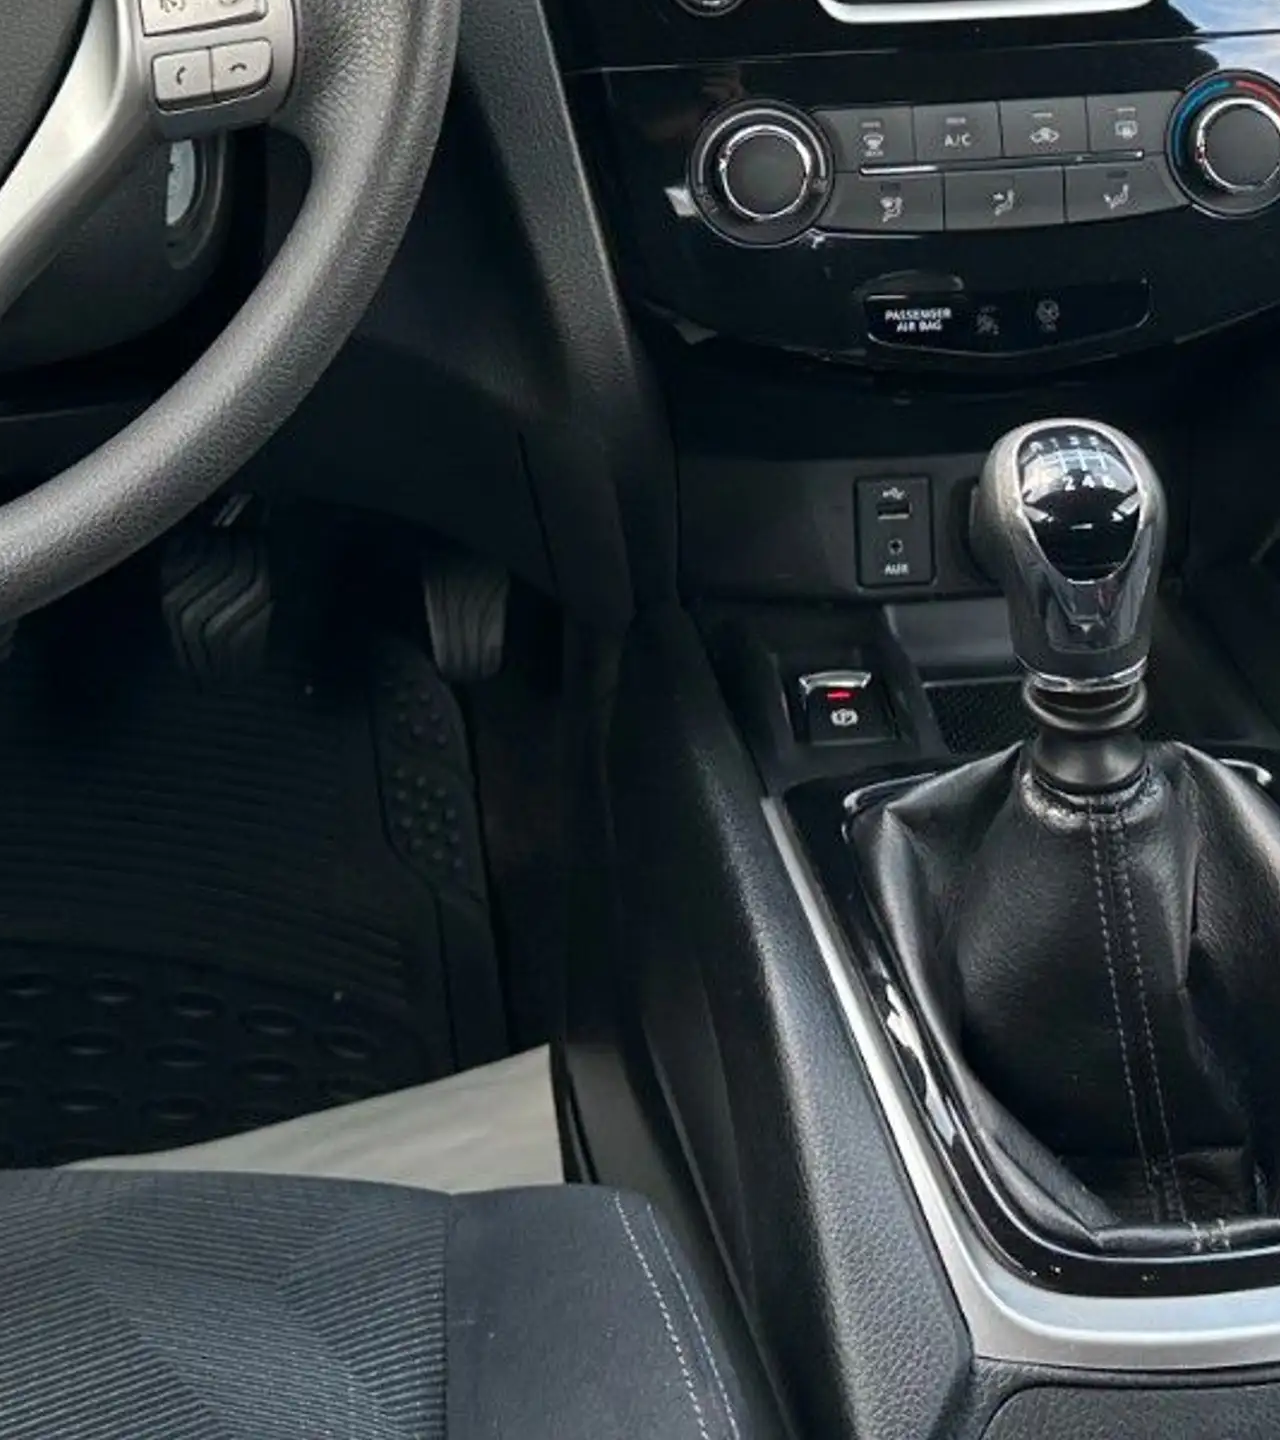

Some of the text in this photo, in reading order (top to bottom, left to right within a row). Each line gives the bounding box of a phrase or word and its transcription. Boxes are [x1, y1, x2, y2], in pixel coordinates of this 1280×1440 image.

[945, 132, 972, 148] A/C
[885, 307, 953, 321] PASSENGER
[896, 320, 943, 333] AIR BAG
[1062, 475, 1076, 491] 2
[1082, 474, 1096, 489] 4
[884, 563, 911, 576] AUX
